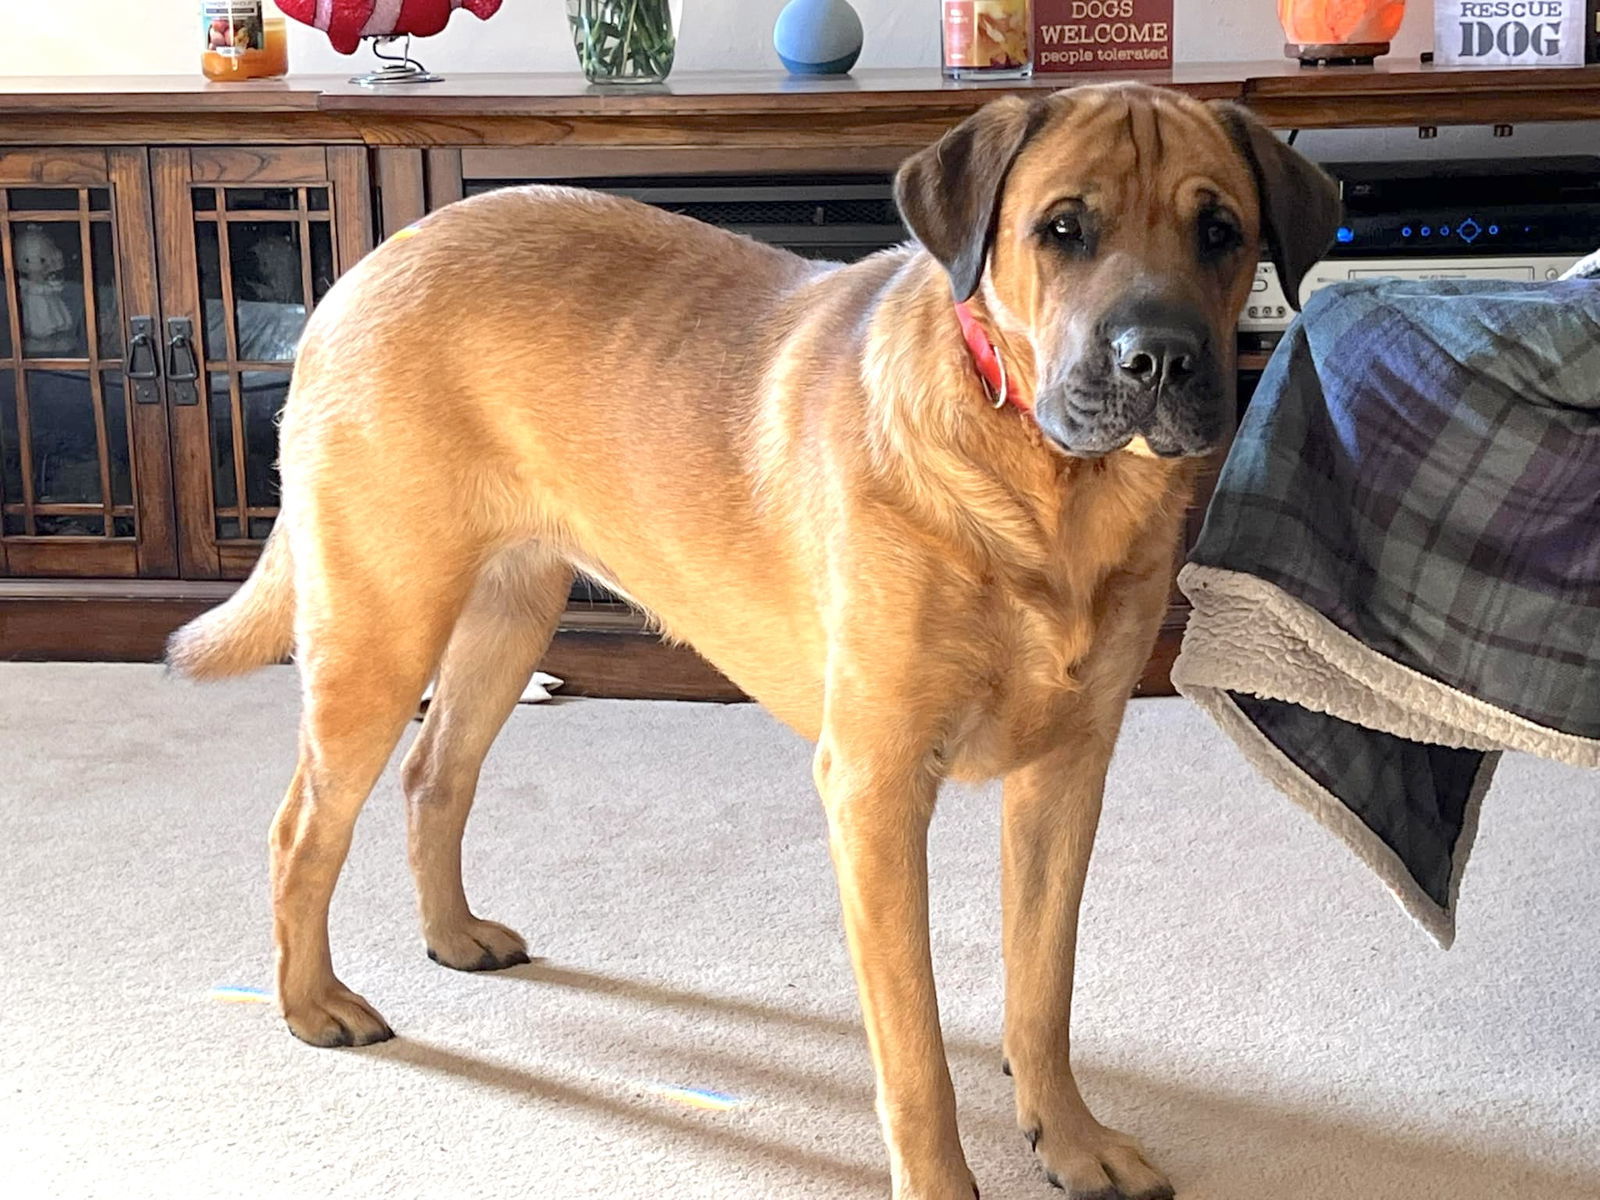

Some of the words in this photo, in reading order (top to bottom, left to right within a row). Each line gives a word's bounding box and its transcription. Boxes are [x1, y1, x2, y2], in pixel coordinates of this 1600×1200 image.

[1071, 0, 1133, 18] DOGS
[1459, 1, 1562, 18] RESCUE
[1040, 23, 1168, 44] WELCOME
[1458, 21, 1562, 57] DOG
[1040, 47, 1093, 65] people
[1097, 46, 1168, 61] tolerated
